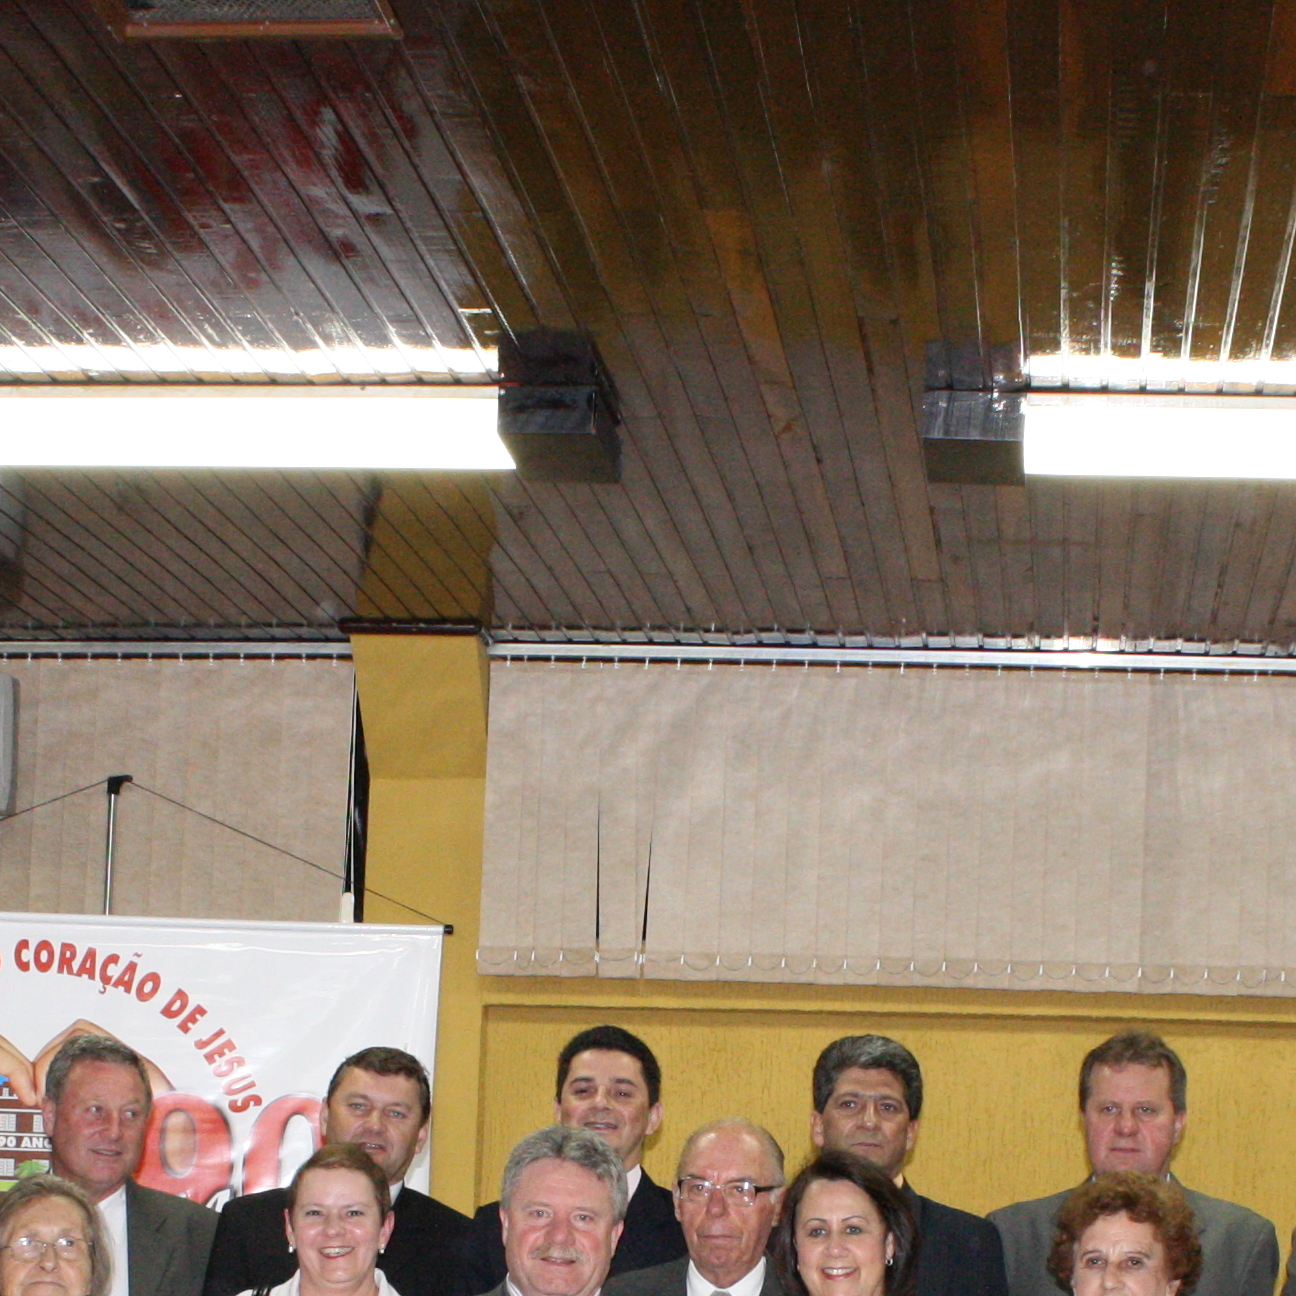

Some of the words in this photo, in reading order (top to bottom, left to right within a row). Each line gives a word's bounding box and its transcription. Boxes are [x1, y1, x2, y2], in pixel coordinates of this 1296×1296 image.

[14, 938, 161, 1003] CORAÇÃO
[160, 987, 208, 1035] DE
[194, 1027, 262, 1113] JESUS
[20, 1136, 53, 1149] ANO
